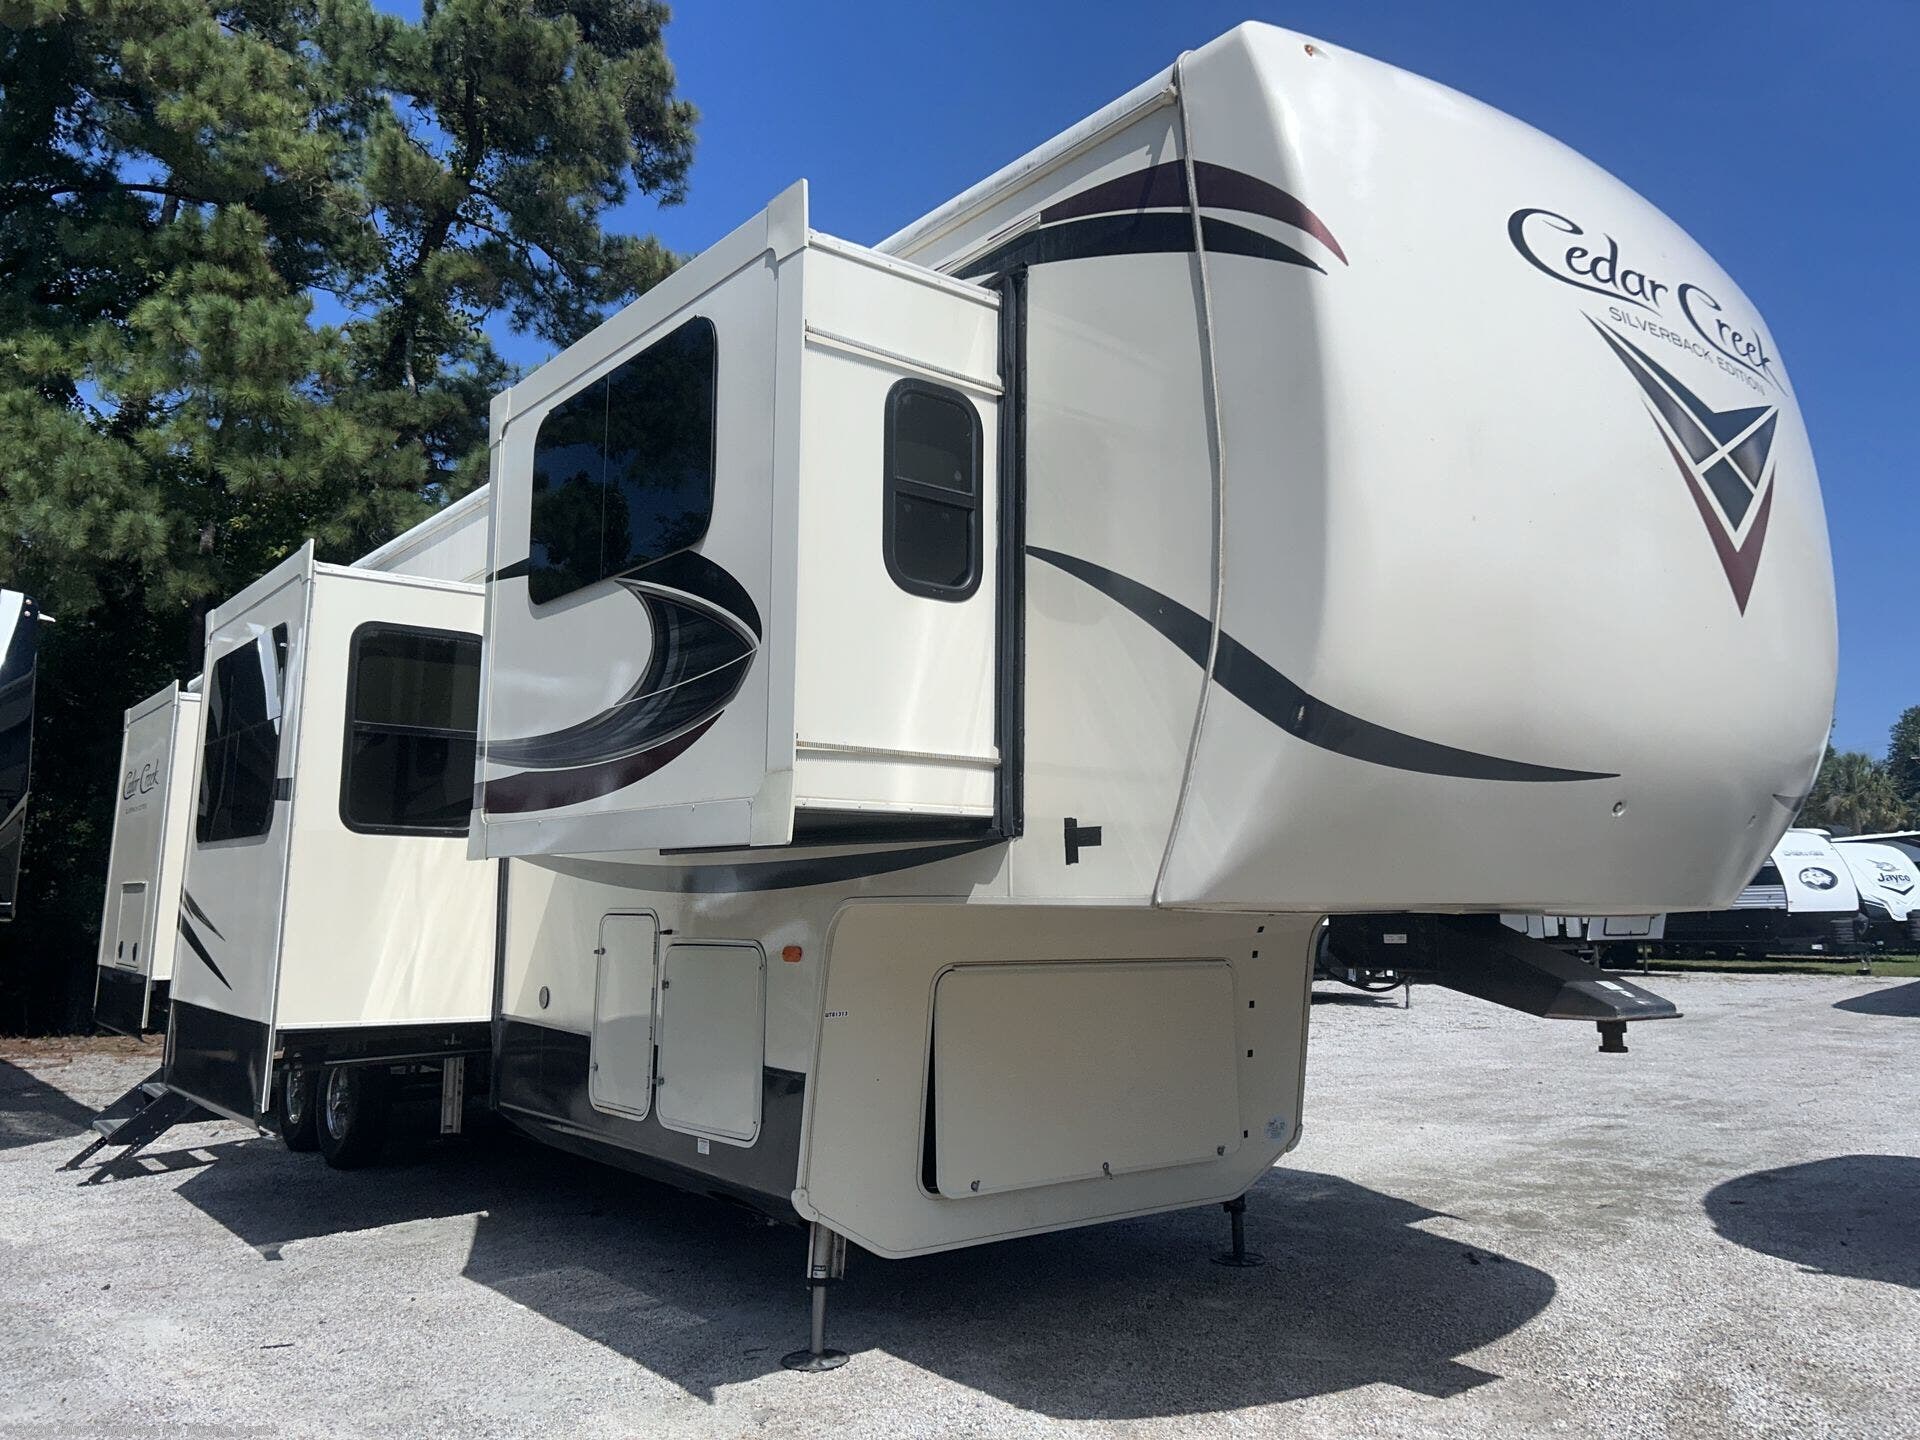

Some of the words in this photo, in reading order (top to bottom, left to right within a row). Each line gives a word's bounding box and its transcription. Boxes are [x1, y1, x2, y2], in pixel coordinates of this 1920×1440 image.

[1507, 207, 1669, 319] Cedar
[1677, 282, 1789, 399] Creek
[1608, 305, 1714, 364] SILVERBACK
[1716, 355, 1766, 397] EDITION
[1877, 872, 1911, 884] Jayco
